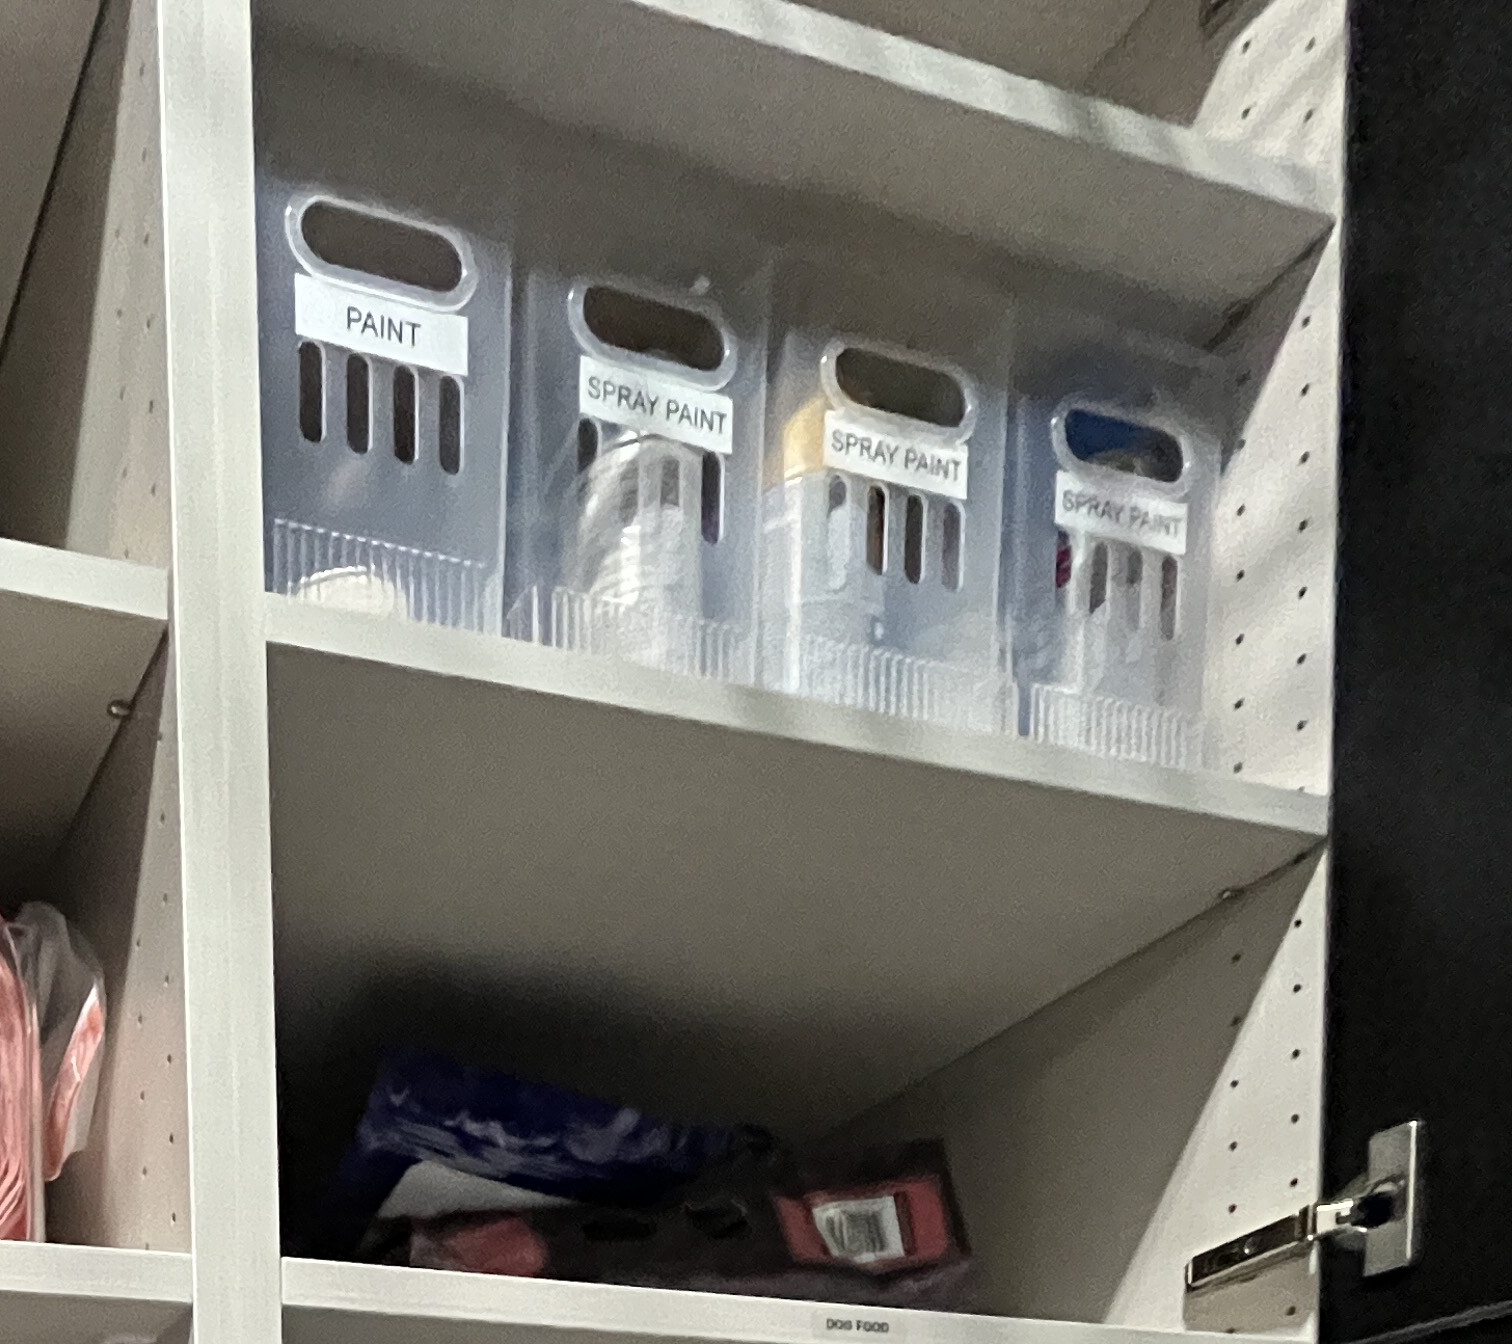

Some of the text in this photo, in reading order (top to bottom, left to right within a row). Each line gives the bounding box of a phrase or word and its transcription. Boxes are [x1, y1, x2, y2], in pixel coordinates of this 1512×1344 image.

[346, 305, 422, 347] PAINT
[587, 376, 728, 435] SPRAY PAINT
[831, 428, 962, 482] SPRAY PAINT
[1062, 489, 1184, 538] SPRAY PAINT
[856, 1320, 890, 1333] FOOD
